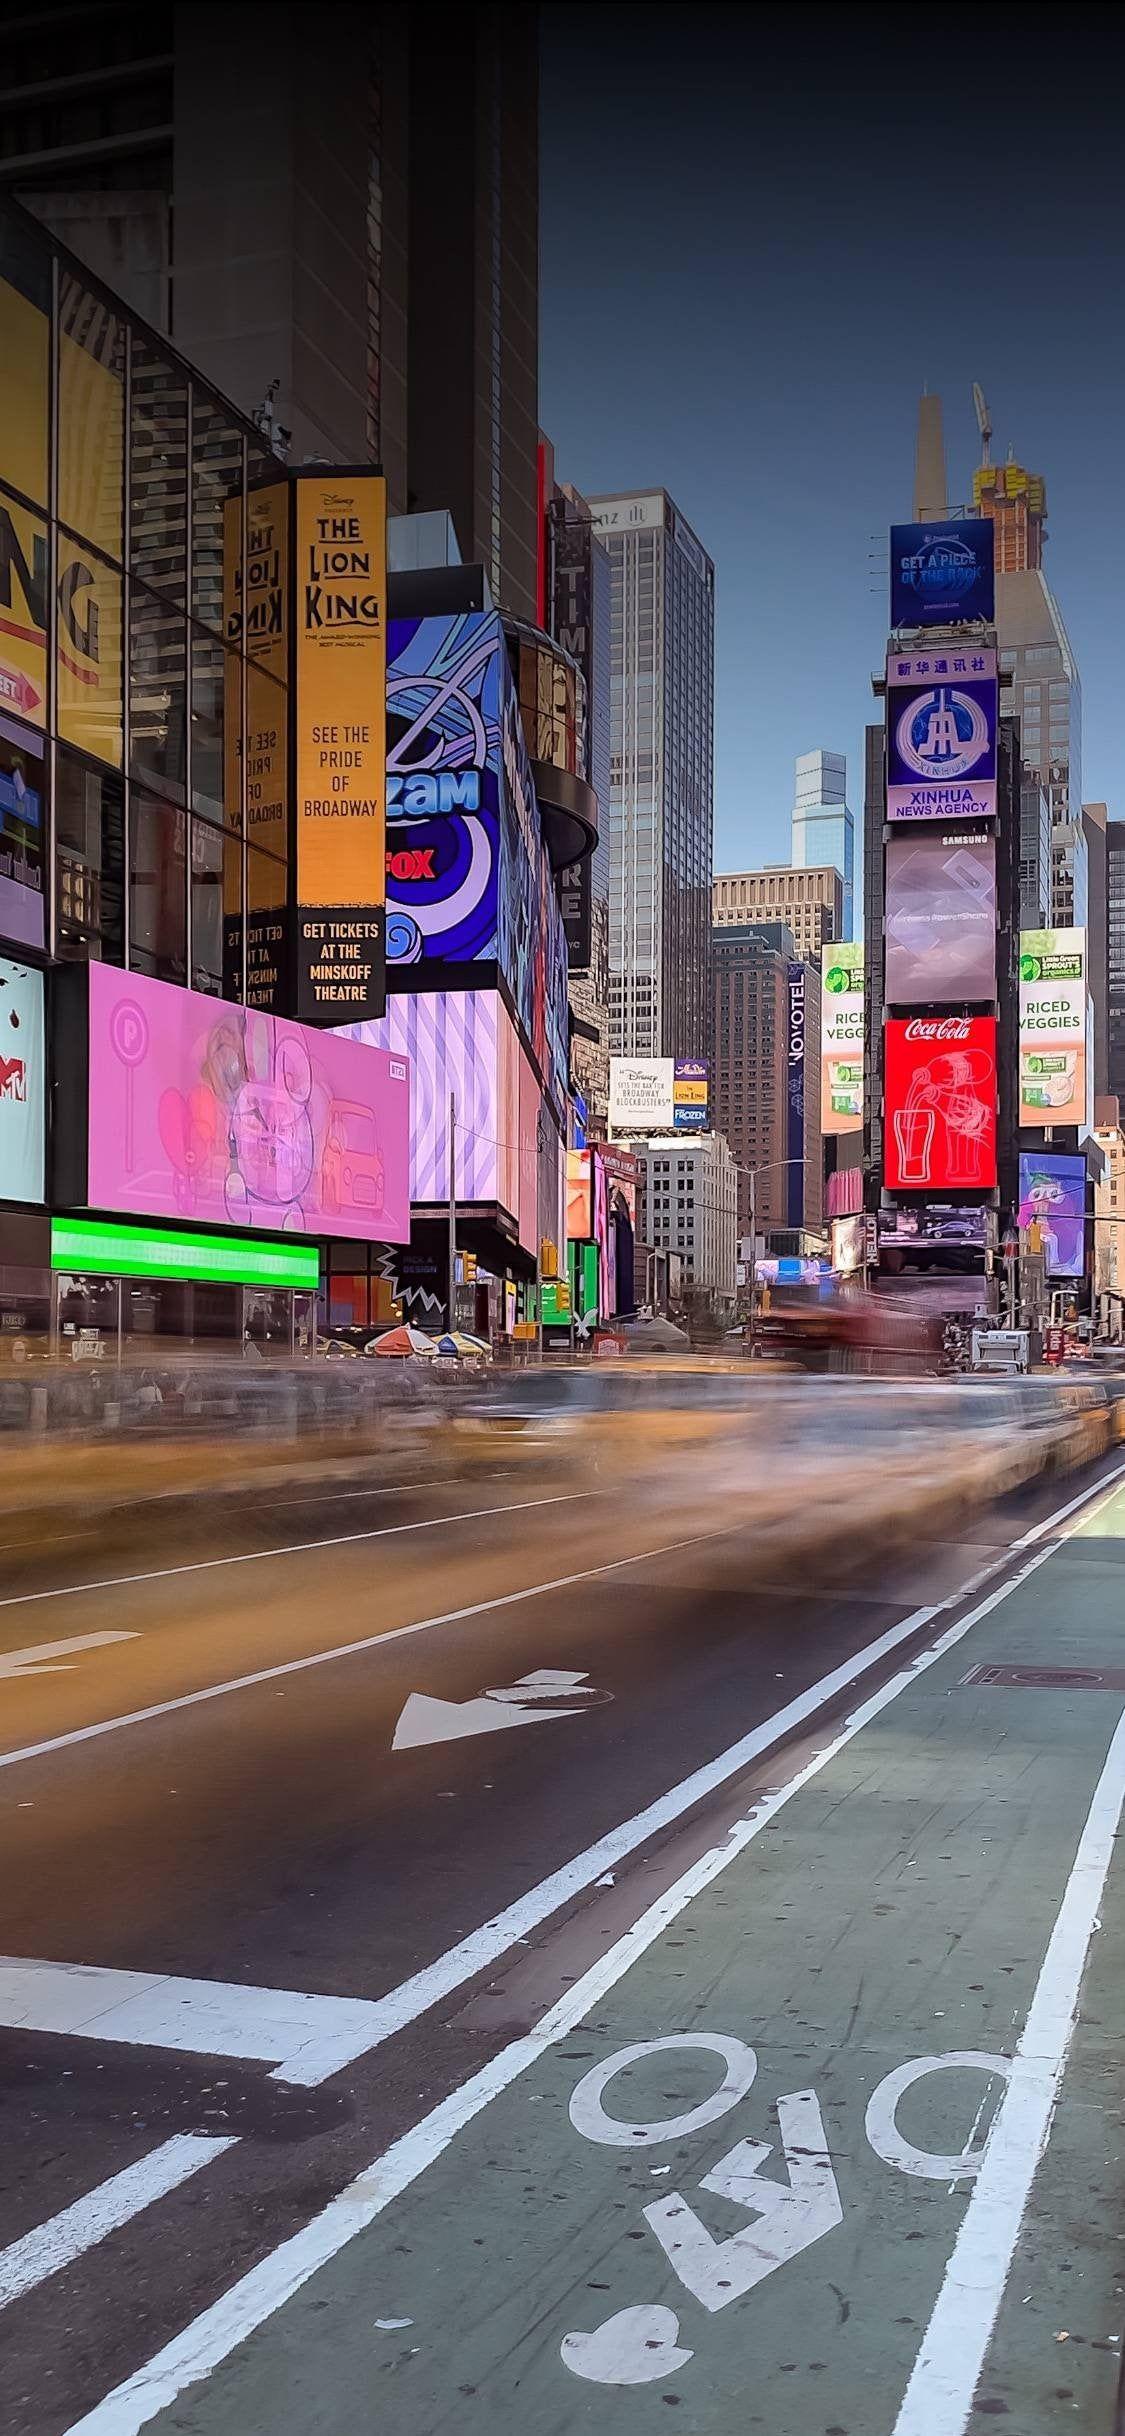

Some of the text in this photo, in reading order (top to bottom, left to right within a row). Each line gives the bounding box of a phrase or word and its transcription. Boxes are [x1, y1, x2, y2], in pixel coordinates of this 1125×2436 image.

[317, 518, 360, 539] THE
[310, 545, 370, 582] LION
[901, 551, 977, 570] GET A PIECE
[306, 585, 379, 629] KING
[897, 657, 986, 677] 新华通讯社
[312, 726, 369, 743] SEE THE
[320, 751, 362, 768] PRIDE
[332, 775, 350, 792] OF
[911, 789, 973, 805] XINHUA
[304, 799, 377, 817] BROADWAY
[896, 802, 988, 817] NEWS AGENCY
[942, 835, 988, 845] SAMSUNG
[303, 923, 379, 938] GET TICKETS
[320, 944, 361, 959] AT THE
[310, 965, 372, 980] MINSKOFF
[314, 985, 367, 1001] THEATRE
[1026, 1001, 1070, 1014] RICED
[789, 973, 805, 1066] NOVOTEL
[1019, 1016, 1080, 1029] VEGGIES
[905, 1017, 974, 1041] Coca-Cola
[623, 1090, 659, 1098] BROADWAY
[675, 1109, 706, 1120] FROZEN
